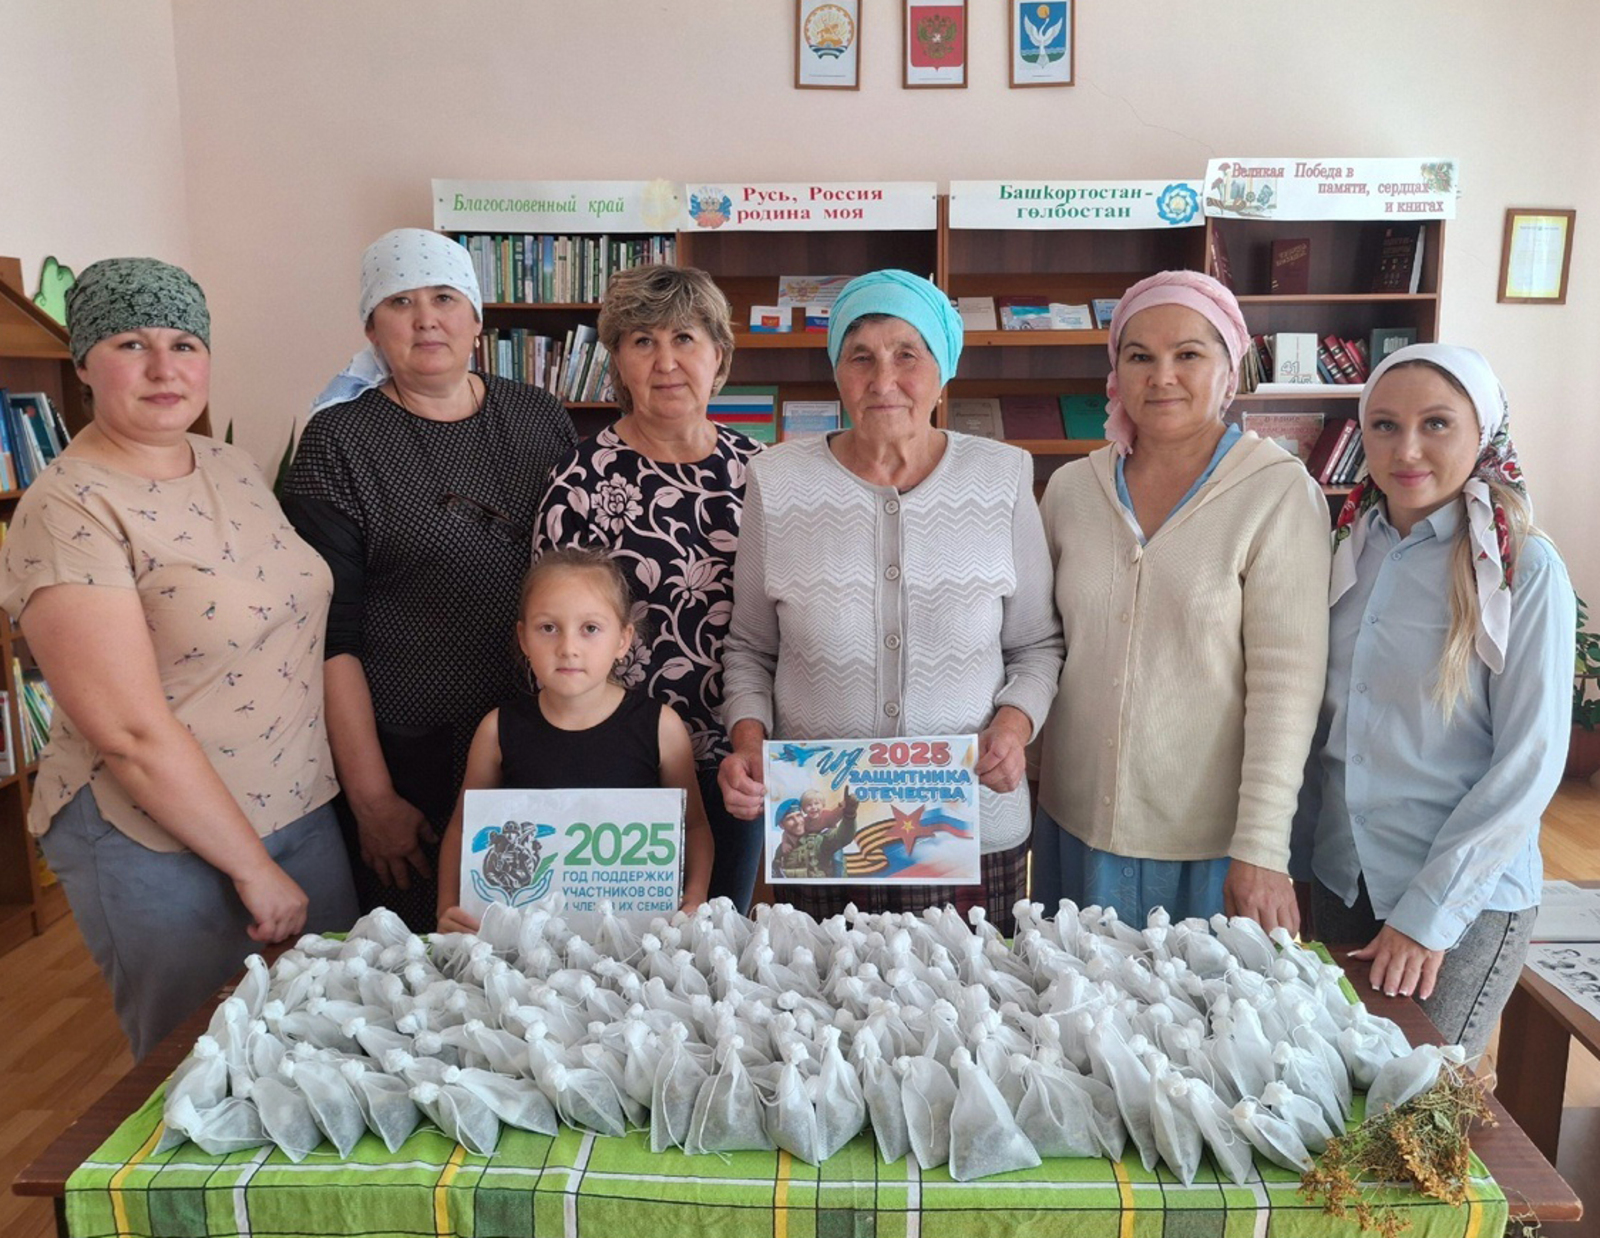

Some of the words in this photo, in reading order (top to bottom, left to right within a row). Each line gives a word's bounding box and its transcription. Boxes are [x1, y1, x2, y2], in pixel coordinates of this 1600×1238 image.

[1231, 162, 1285, 179] Великая
[1294, 162, 1342, 179] Победа
[1346, 167, 1354, 178] в
[743, 187, 798, 205] Русь,
[809, 187, 883, 201] Россия
[1318, 182, 1370, 196] памяти,
[1377, 182, 1430, 196] сердцах
[453, 193, 577, 213] Благословенный
[588, 197, 625, 217] край
[1385, 202, 1393, 212] и
[1397, 202, 1444, 214] книгах
[736, 208, 811, 224] родина
[823, 208, 864, 219] моя
[868, 742, 951, 767] 2025
[848, 770, 971, 785] ЗАЩИТНИКА
[855, 786, 966, 802] ОТЕЧЕСТВА
[563, 822, 676, 866] 2025
[563, 871, 588, 883] ГОД
[592, 871, 674, 883] ПОДДЕРЖКИ
[562, 886, 645, 897] УЧАСТНИКОВ
[647, 886, 674, 897] СВО
[619, 902, 633, 911] ИХ
[637, 899, 673, 911] СЕМЕЙ
